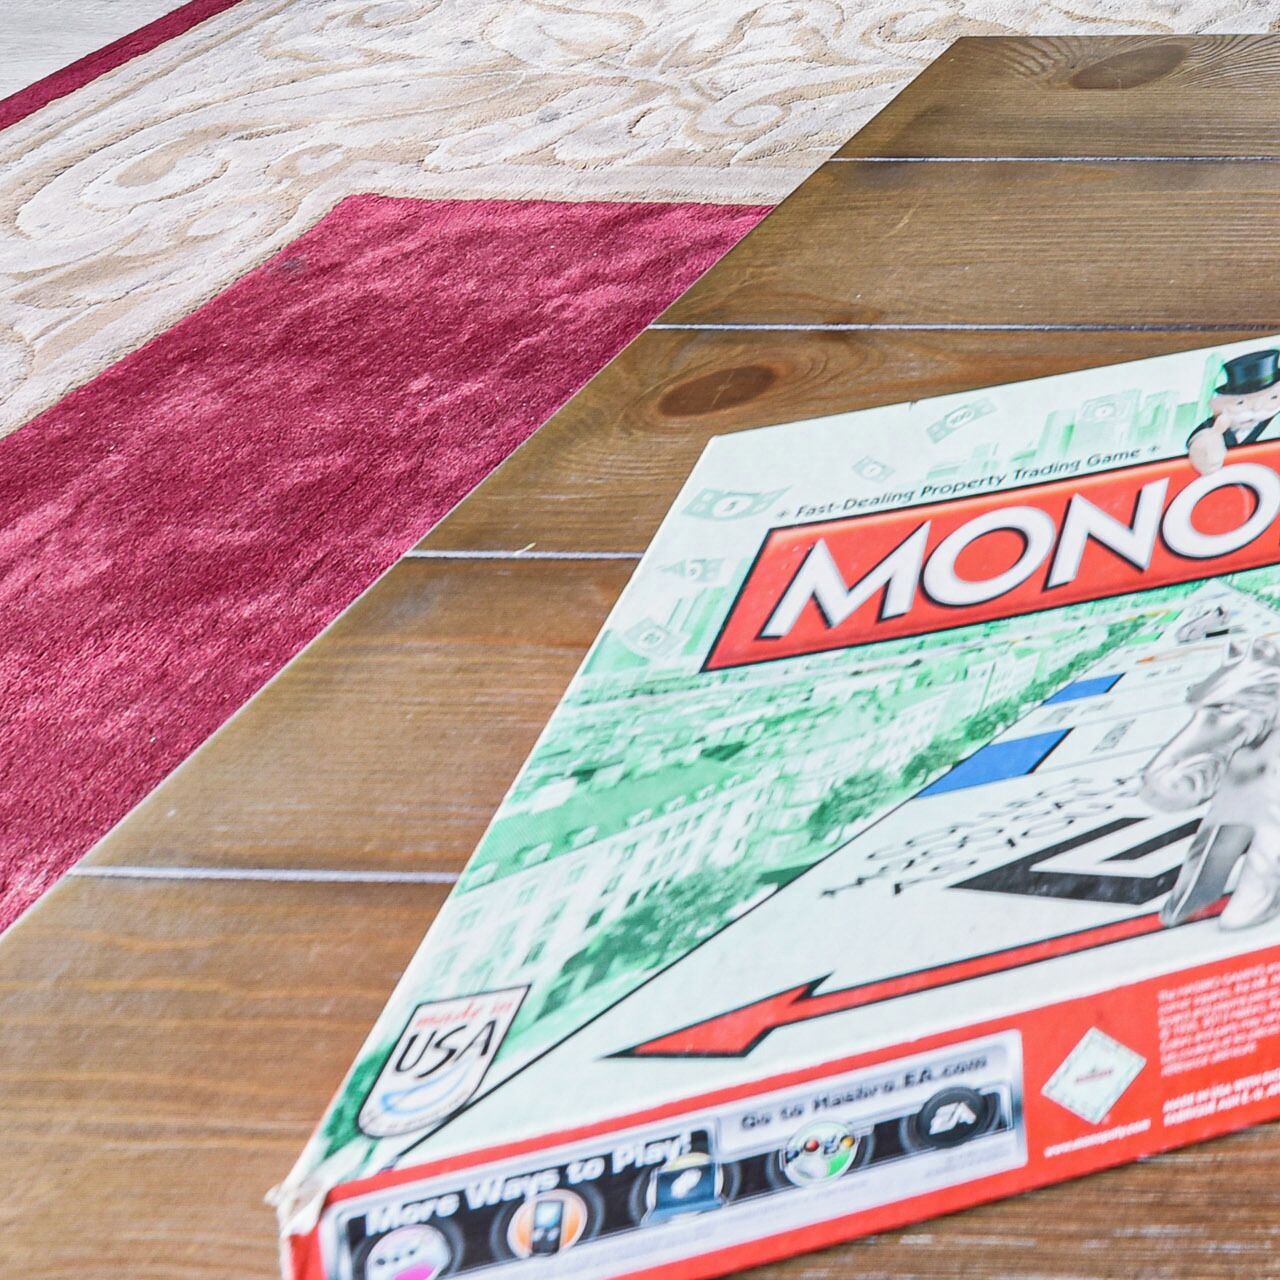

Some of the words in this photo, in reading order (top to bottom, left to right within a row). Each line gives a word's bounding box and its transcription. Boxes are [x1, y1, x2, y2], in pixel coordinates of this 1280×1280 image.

[795, 487, 914, 518] Fast-Dealing
[920, 472, 1008, 499] Property
[1012, 458, 1081, 481] Trading
[1086, 447, 1141, 467] Game
[415, 999, 483, 1027] made
[491, 1001, 513, 1015] in
[395, 1019, 498, 1078] USA
[740, 1113, 771, 1131] Go
[780, 1104, 804, 1119] to
[364, 1192, 460, 1237] More
[464, 1168, 560, 1211] Ways
[566, 1156, 606, 1184] to
[610, 1131, 693, 1173] Play!
